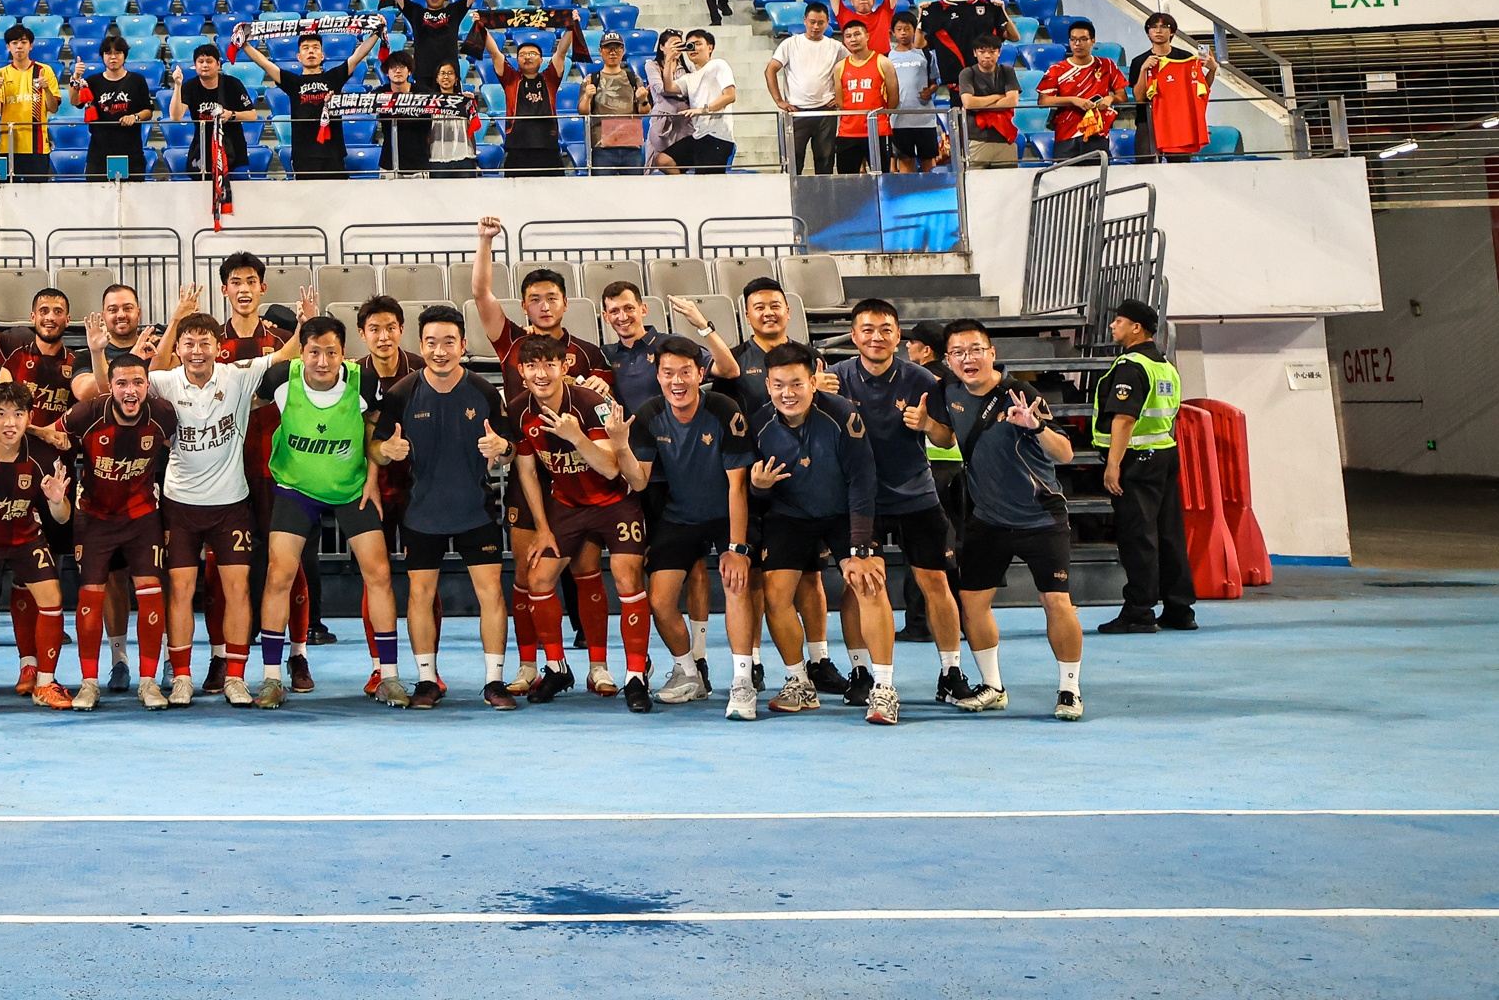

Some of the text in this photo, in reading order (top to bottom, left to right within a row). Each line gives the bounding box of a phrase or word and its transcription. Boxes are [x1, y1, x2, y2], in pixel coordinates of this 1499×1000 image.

[851, 91, 864, 104] 10
[1343, 347, 1395, 384] GATE 2
[179, 412, 236, 444] 速力奥
[179, 429, 236, 452] SULI AURA
[93, 468, 118, 481] SULI
[94, 455, 150, 473] 速力奥
[616, 521, 642, 543] 36
[32, 546, 56, 569] 21
